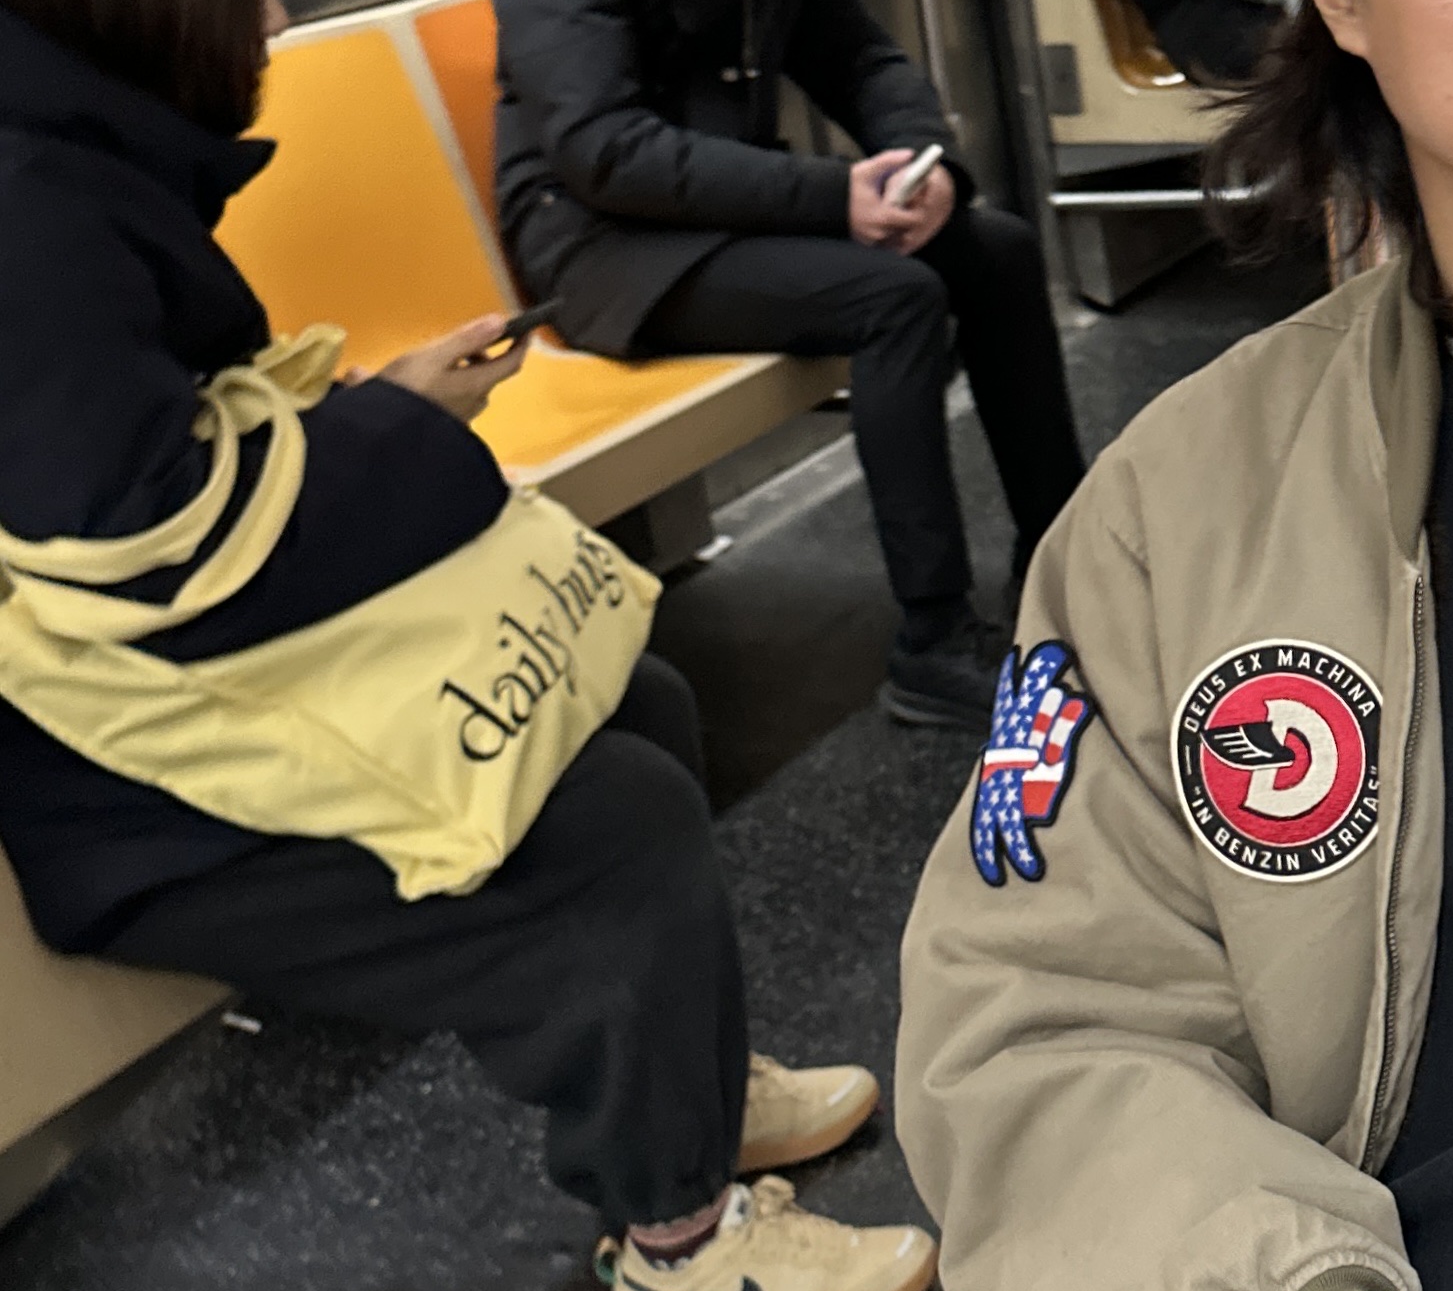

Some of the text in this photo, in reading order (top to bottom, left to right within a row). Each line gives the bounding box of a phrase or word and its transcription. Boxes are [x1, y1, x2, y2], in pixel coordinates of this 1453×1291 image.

[438, 607, 578, 763] daily
[1183, 648, 1377, 734] DEUS EX MACHINA
[1213, 826, 1300, 871] BENZIN
